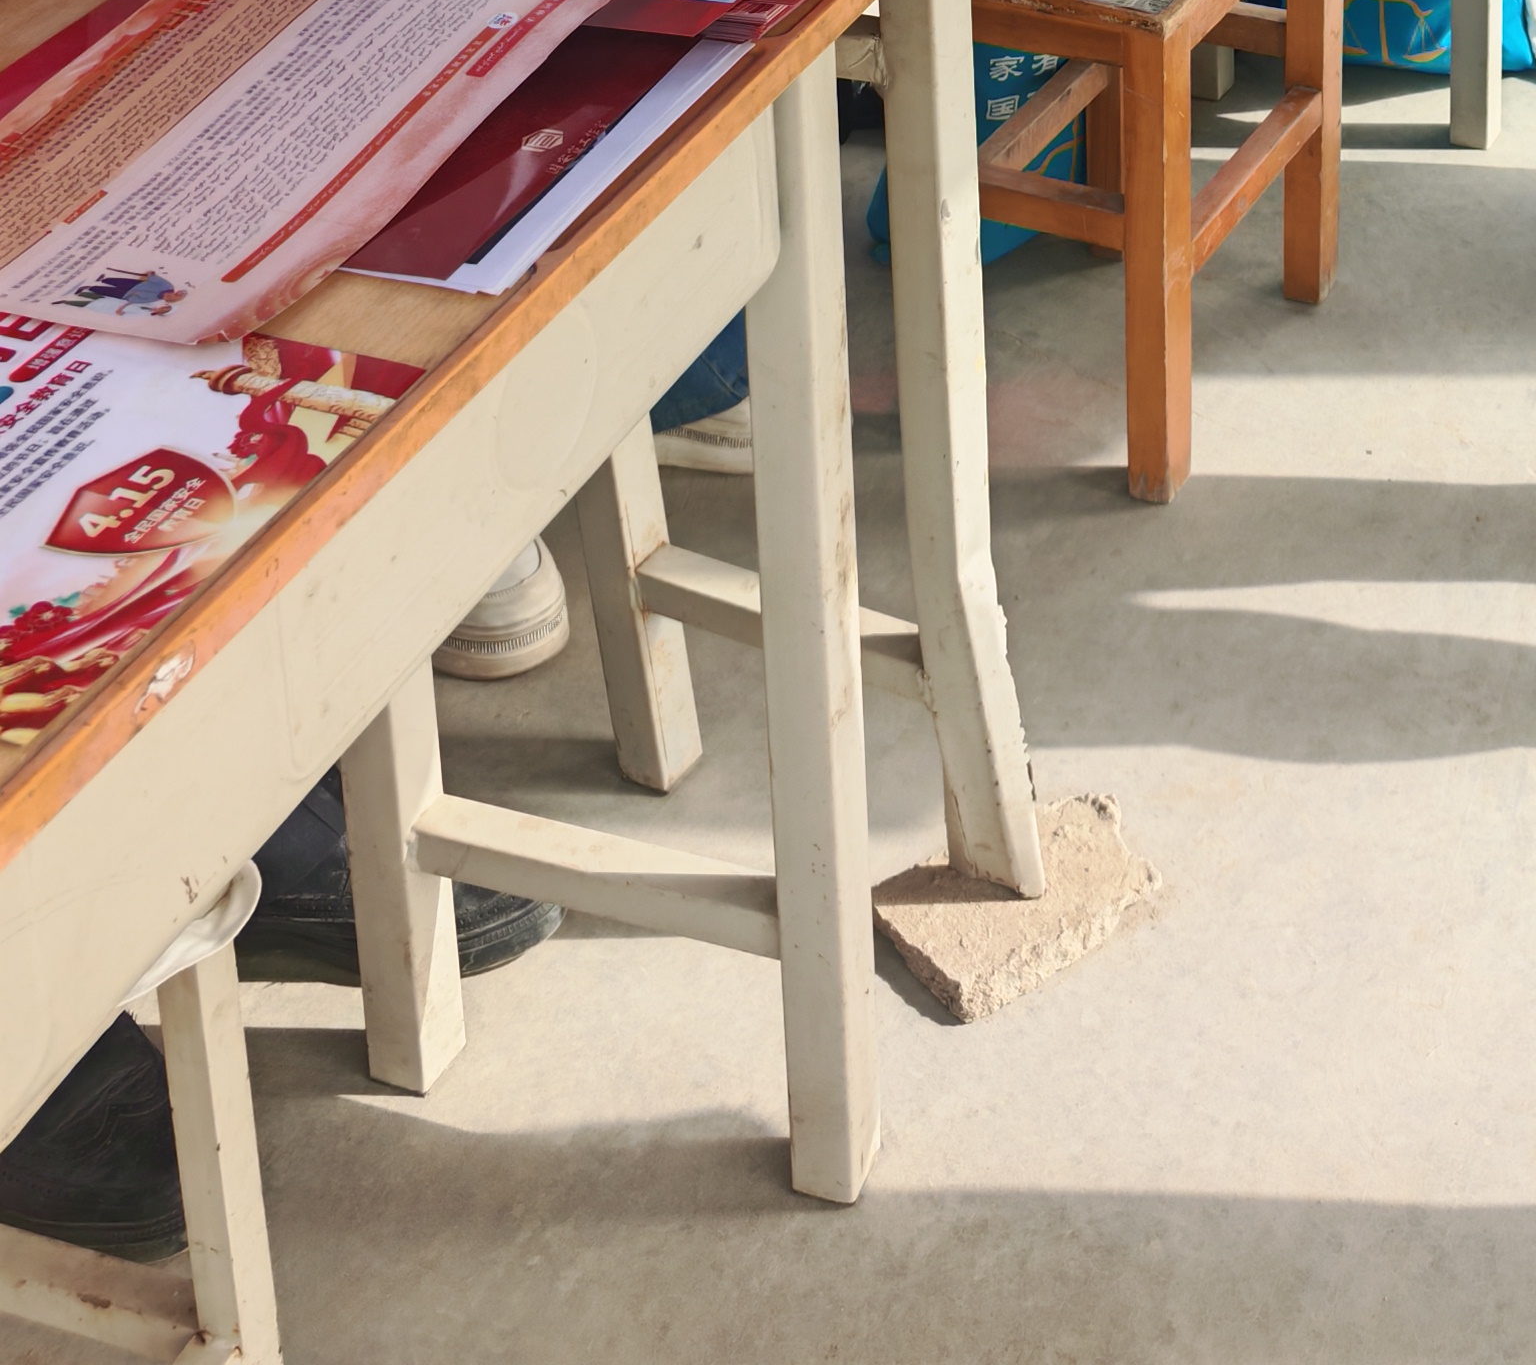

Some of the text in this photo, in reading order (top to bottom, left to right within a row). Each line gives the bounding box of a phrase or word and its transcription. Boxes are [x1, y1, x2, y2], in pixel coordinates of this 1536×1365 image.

[990, 55, 1060, 82] 家有
[0, 360, 92, 434] 安全教育日
[77, 465, 176, 538] 4.15
[124, 477, 207, 544] 全民国家安全
